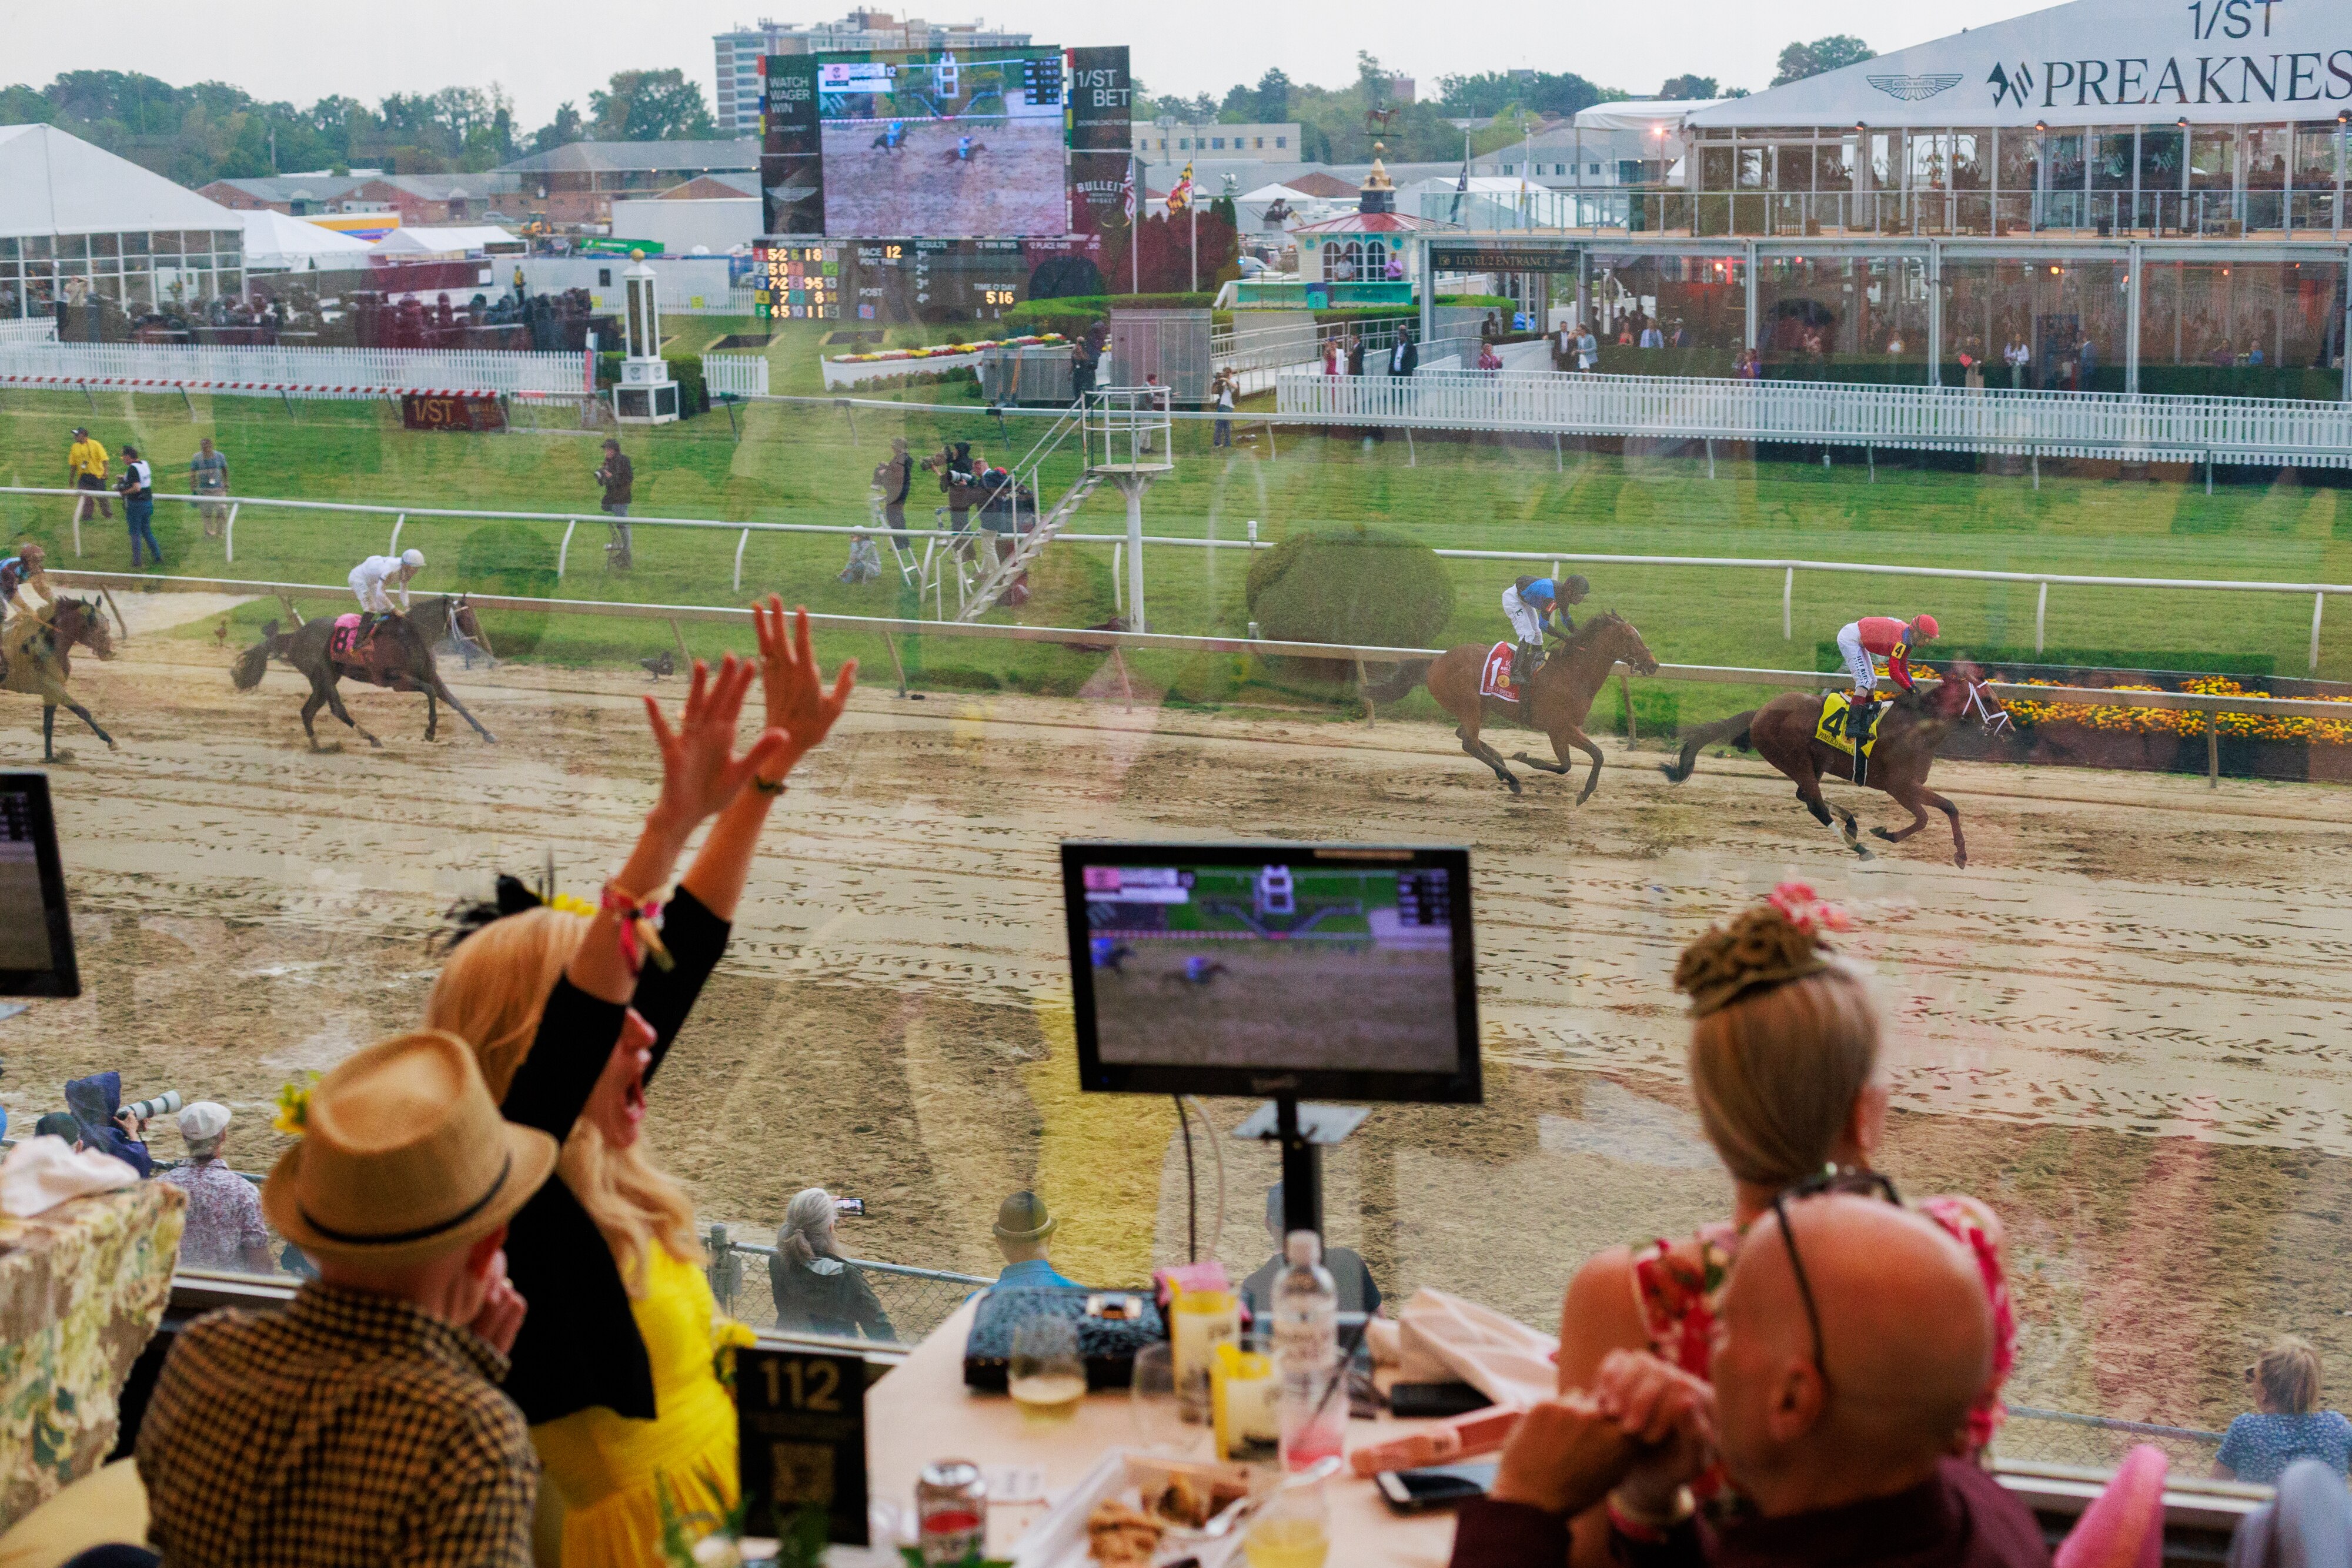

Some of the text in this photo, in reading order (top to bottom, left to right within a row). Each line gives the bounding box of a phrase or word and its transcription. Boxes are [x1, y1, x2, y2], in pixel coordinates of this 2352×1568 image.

[2188, 0, 2283, 40] 1/ST
[769, 77, 809, 88] WATCH
[1076, 69, 1117, 88] 1/ST
[2041, 49, 2352, 107] PREAKNES
[769, 89, 811, 101] WAGER
[1093, 89, 1130, 107] BET
[770, 102, 793, 113] WIN
[1077, 180, 1125, 193] BULLEIT
[758, 249, 764, 260] 1
[790, 249, 799, 260] 6
[858, 248, 882, 256] RACE
[886, 245, 903, 259] 12
[1456, 255, 1486, 265] LEVEL
[1486, 255, 1494, 265] 2
[1496, 256, 1549, 266] ENTRANCE
[757, 263, 764, 274] 2
[768, 262, 789, 276] 50
[757, 278, 765, 289] 3
[793, 278, 800, 288] 8
[824, 278, 837, 289] 13
[759, 292, 766, 302] 4
[779, 291, 789, 304] 7
[814, 290, 824, 304] 8
[859, 288, 883, 297] POST
[760, 306, 766, 316] 5
[770, 305, 790, 318] 45
[791, 305, 804, 316] 10
[413, 399, 454, 423] 1/ST
[333, 626, 350, 654] 8
[1895, 645, 1903, 657] 4
[1856, 656, 1865, 667] JEFF
[1491, 657, 1502, 687] 1
[1822, 707, 1848, 738] 4
[1818, 731, 1854, 755] PIMLICO SPECIA
[760, 1358, 841, 1411] 112
